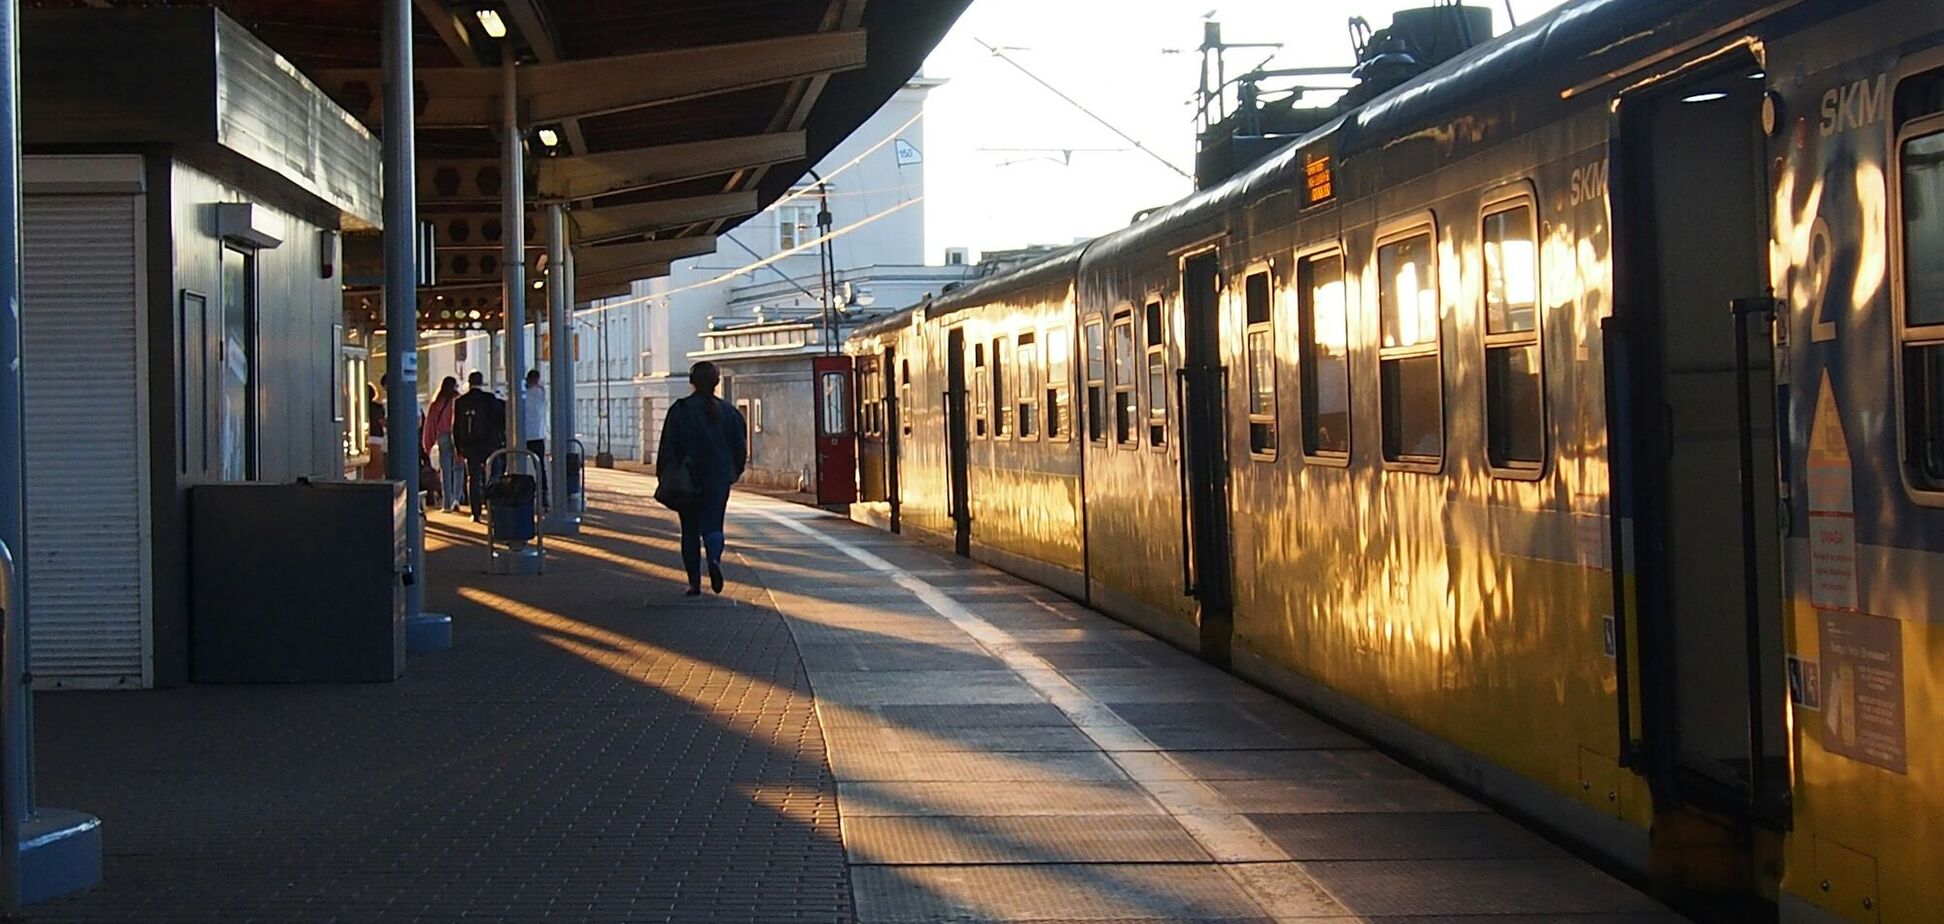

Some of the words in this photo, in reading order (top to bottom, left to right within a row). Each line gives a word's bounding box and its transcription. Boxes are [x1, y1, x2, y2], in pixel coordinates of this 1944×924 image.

[1820, 73, 1887, 137] SKM
[1570, 158, 1609, 207] SKM
[1808, 216, 1836, 342] 2
